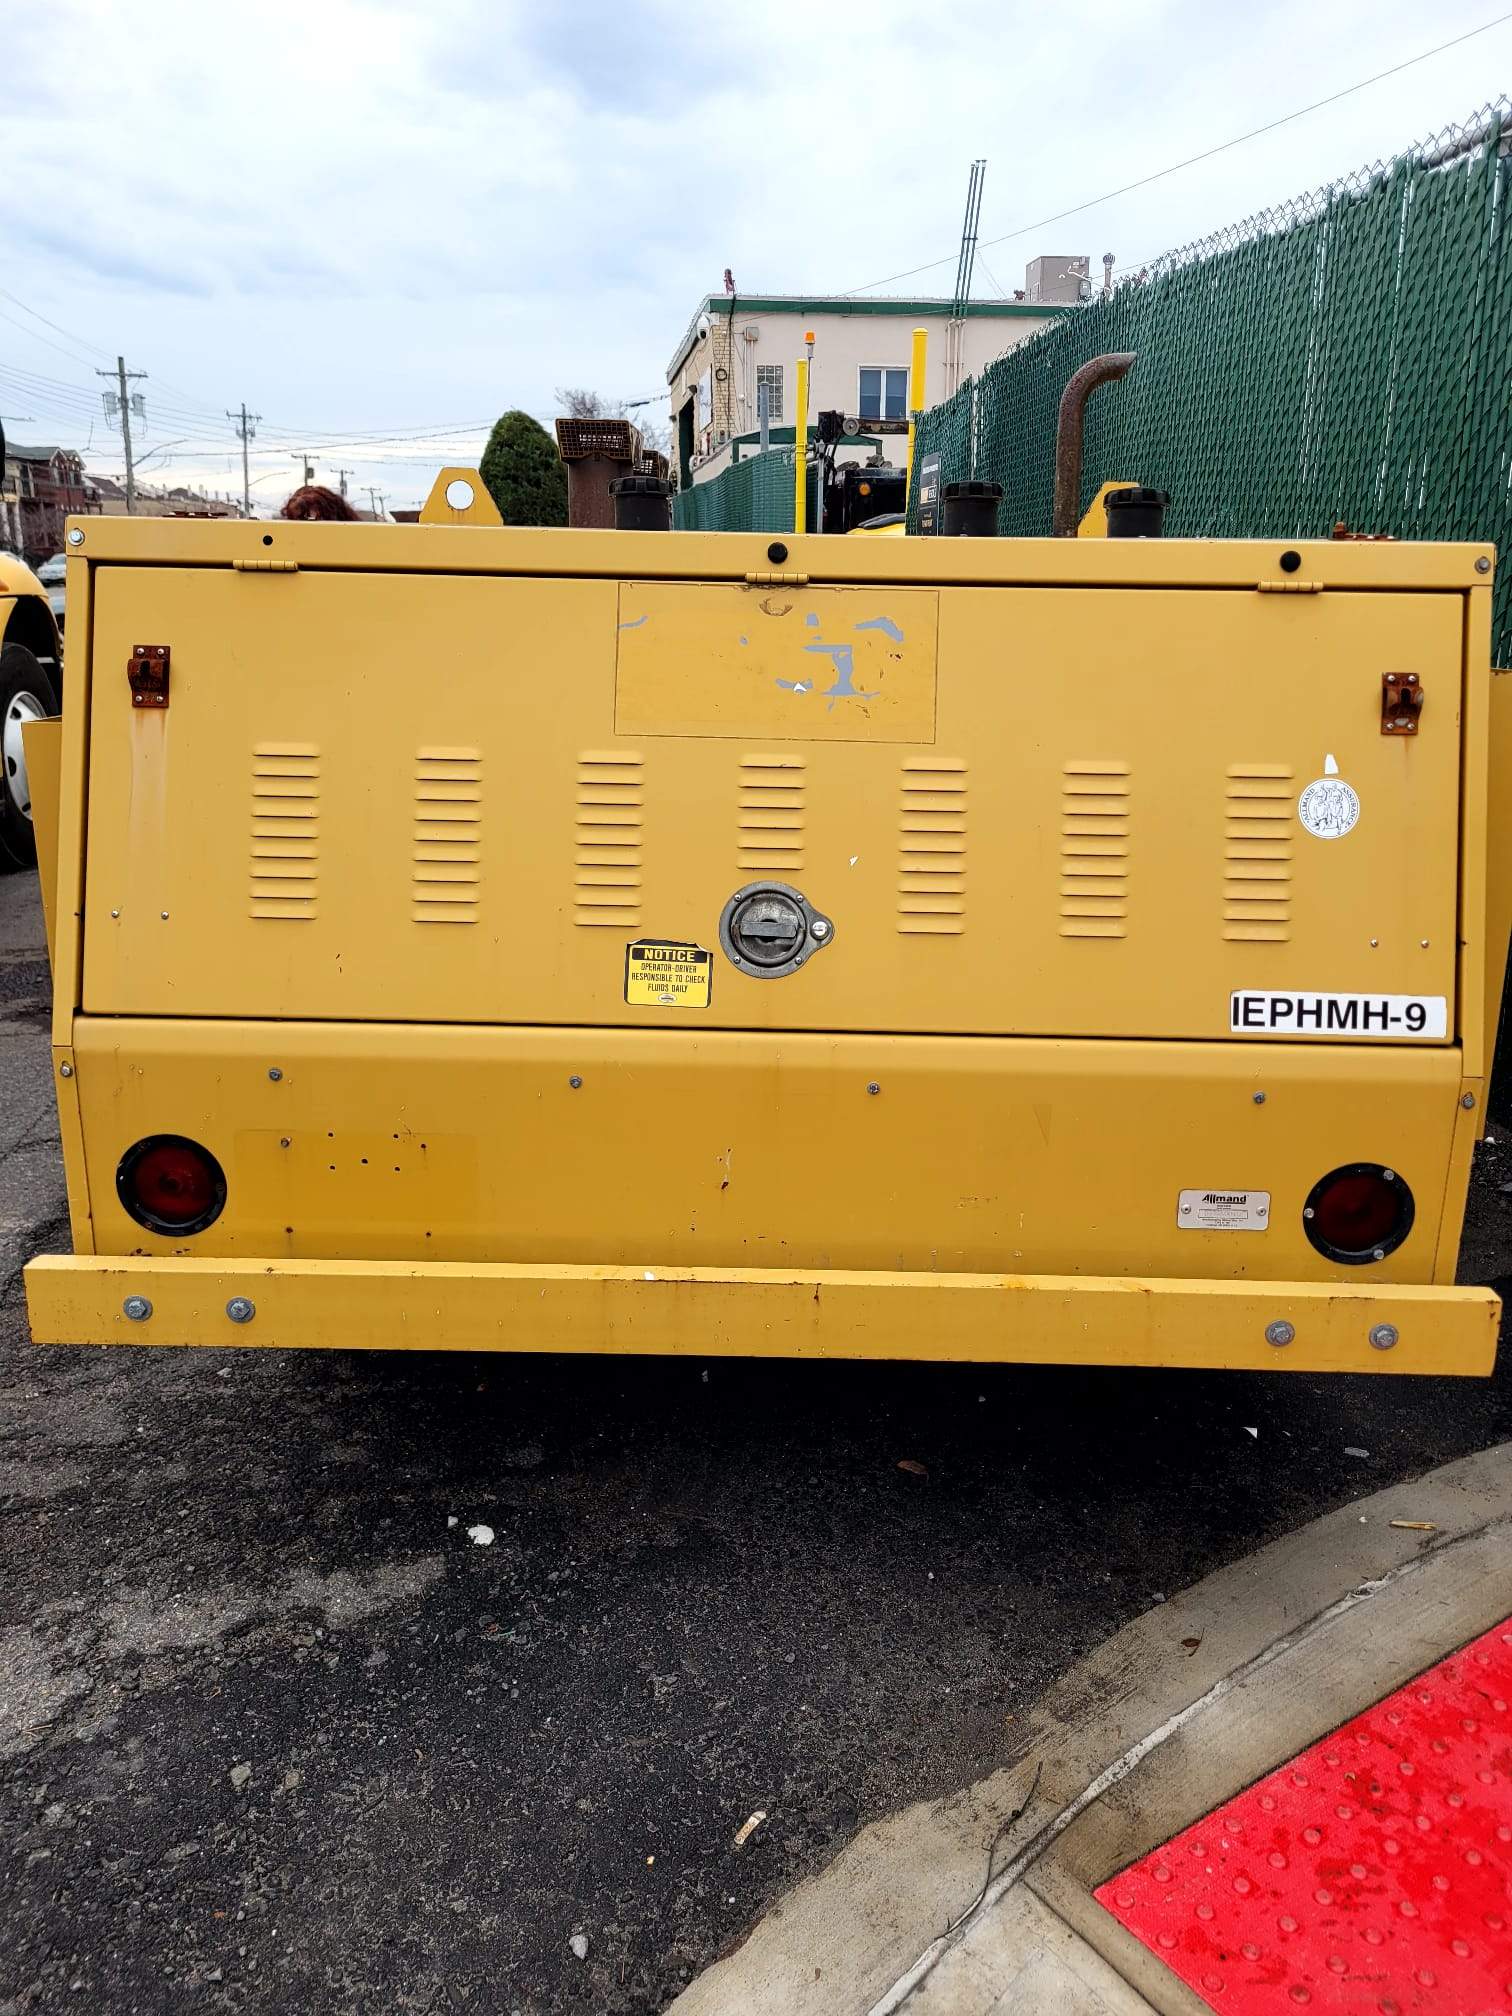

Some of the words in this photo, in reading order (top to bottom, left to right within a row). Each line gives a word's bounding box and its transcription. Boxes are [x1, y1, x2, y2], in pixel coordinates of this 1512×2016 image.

[645, 949, 695, 961] NOTICE
[641, 963, 696, 973] OPERATOR-DRIVER
[631, 972, 673, 982] RESPONSIBLE
[675, 974, 683, 983] TO
[685, 975, 706, 984] CHECK
[647, 983, 669, 992] FLUIDS
[671, 984, 688, 993] DAILY
[1232, 997, 1427, 1032] IEPHMH-9
[1202, 1194, 1246, 1204] Allmand
